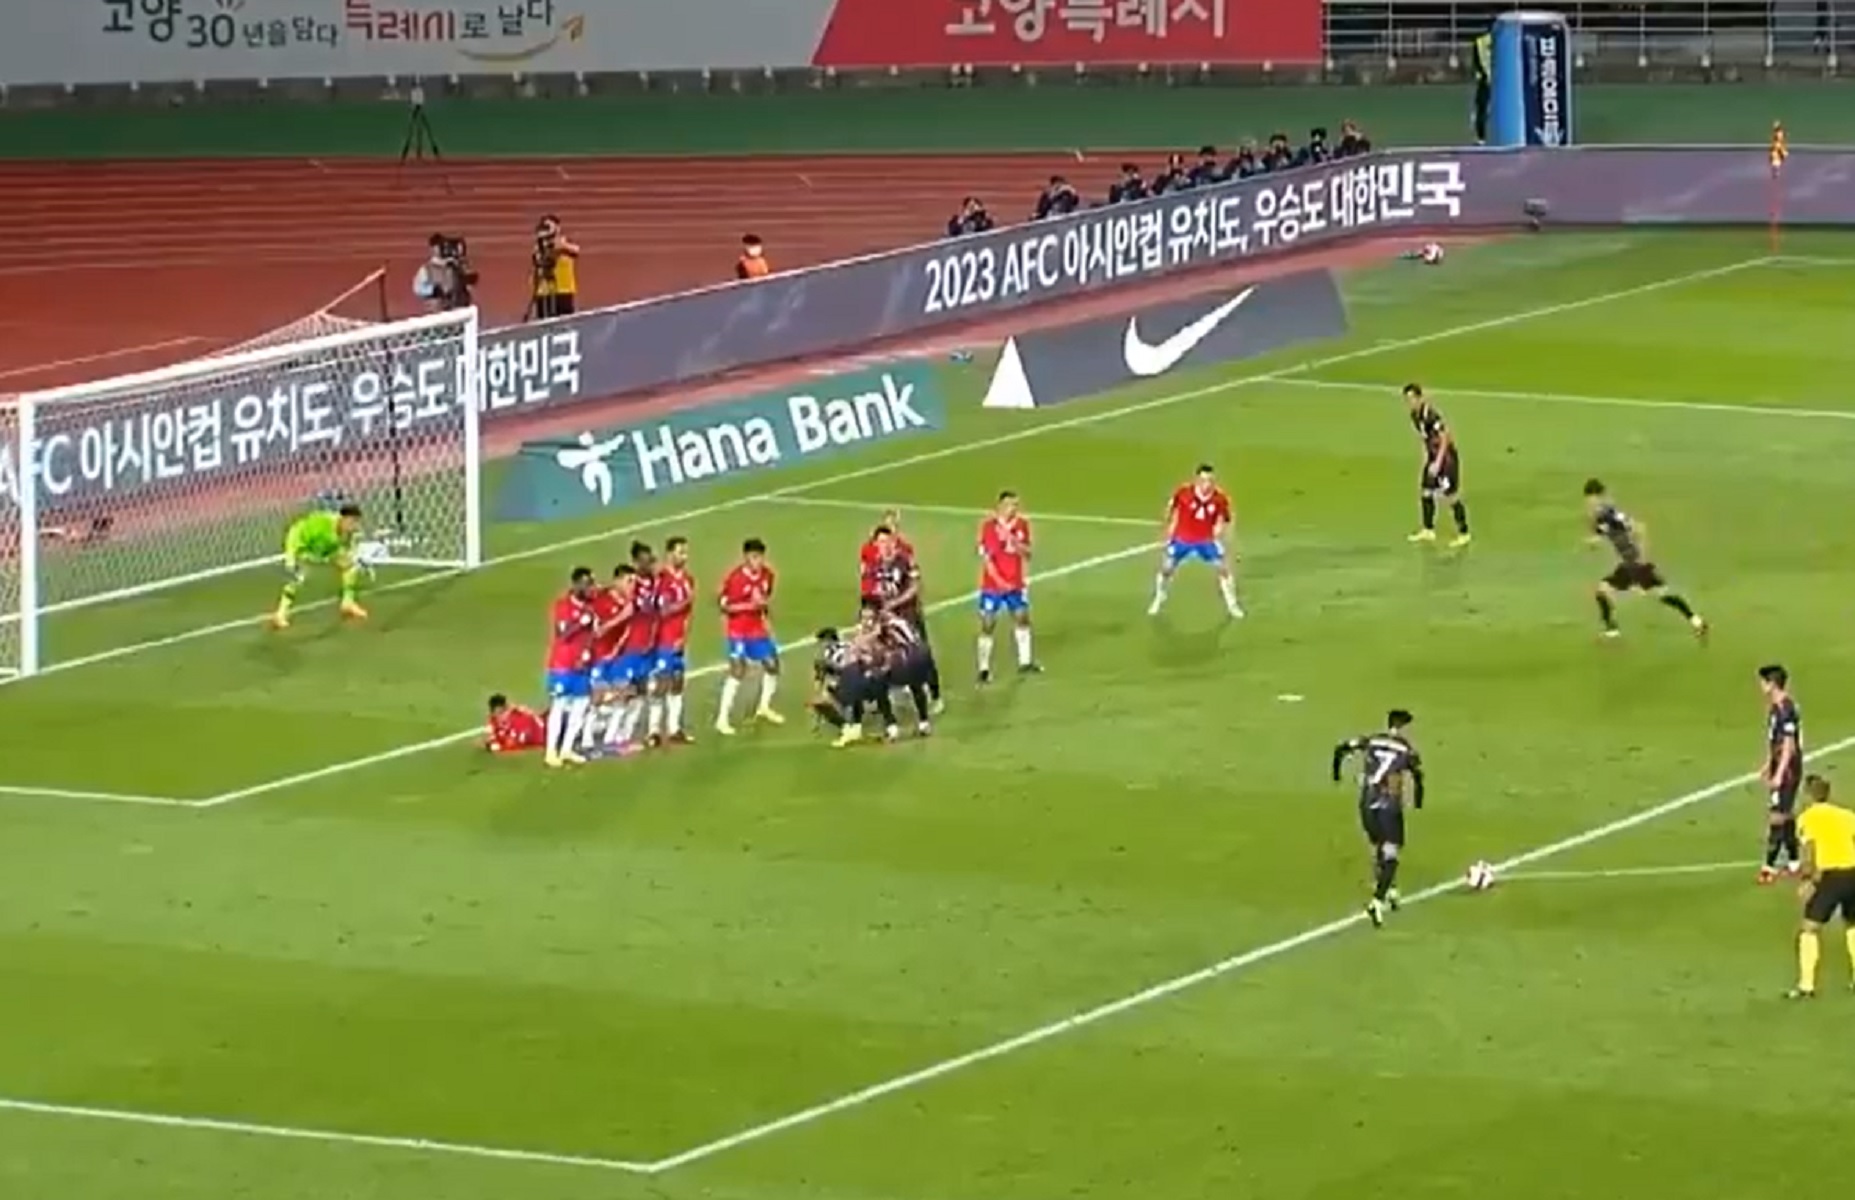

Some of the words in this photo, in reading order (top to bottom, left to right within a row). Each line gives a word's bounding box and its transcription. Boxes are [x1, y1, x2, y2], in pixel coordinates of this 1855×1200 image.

[924, 248, 995, 313] 2023
[1001, 235, 1058, 296] AFC
[1063, 217, 1162, 284] 아시안컵
[1168, 196, 1249, 264] 유치도,
[1253, 179, 1328, 245] 우승도
[1330, 160, 1466, 228] 대한민국
[81, 399, 221, 489] 아시안컵
[352, 358, 448, 434] 우승도
[632, 415, 781, 490] Hana
[787, 373, 927, 454] Bank
[1368, 750, 1398, 785] 7
